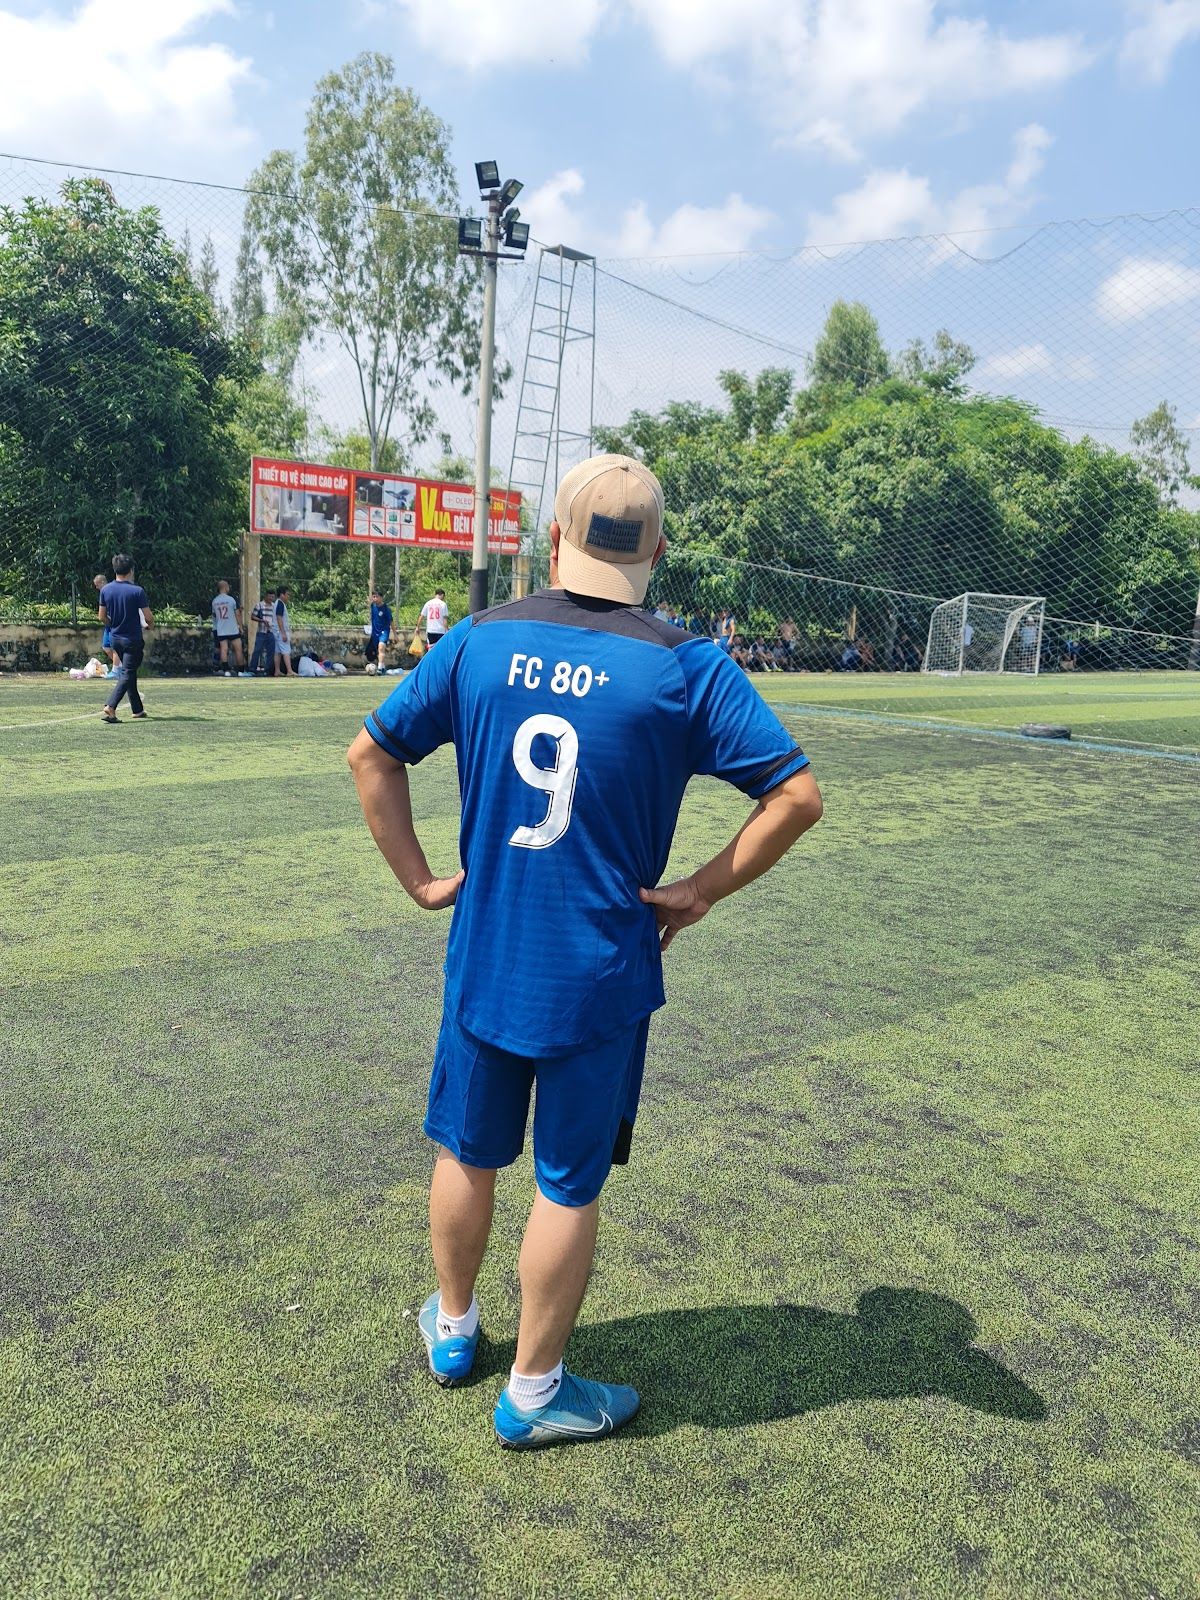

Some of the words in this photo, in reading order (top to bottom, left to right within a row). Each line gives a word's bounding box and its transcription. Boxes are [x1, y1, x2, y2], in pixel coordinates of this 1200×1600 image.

[258, 466, 278, 481] THIẾT
[300, 473, 318, 487] SINH
[318, 475, 333, 489] CAO
[333, 474, 348, 490] CẤP
[217, 605, 229, 620] 12
[429, 606, 441, 620] 28
[507, 653, 543, 690] FC
[550, 661, 610, 698] 80+
[508, 713, 579, 850] 9
